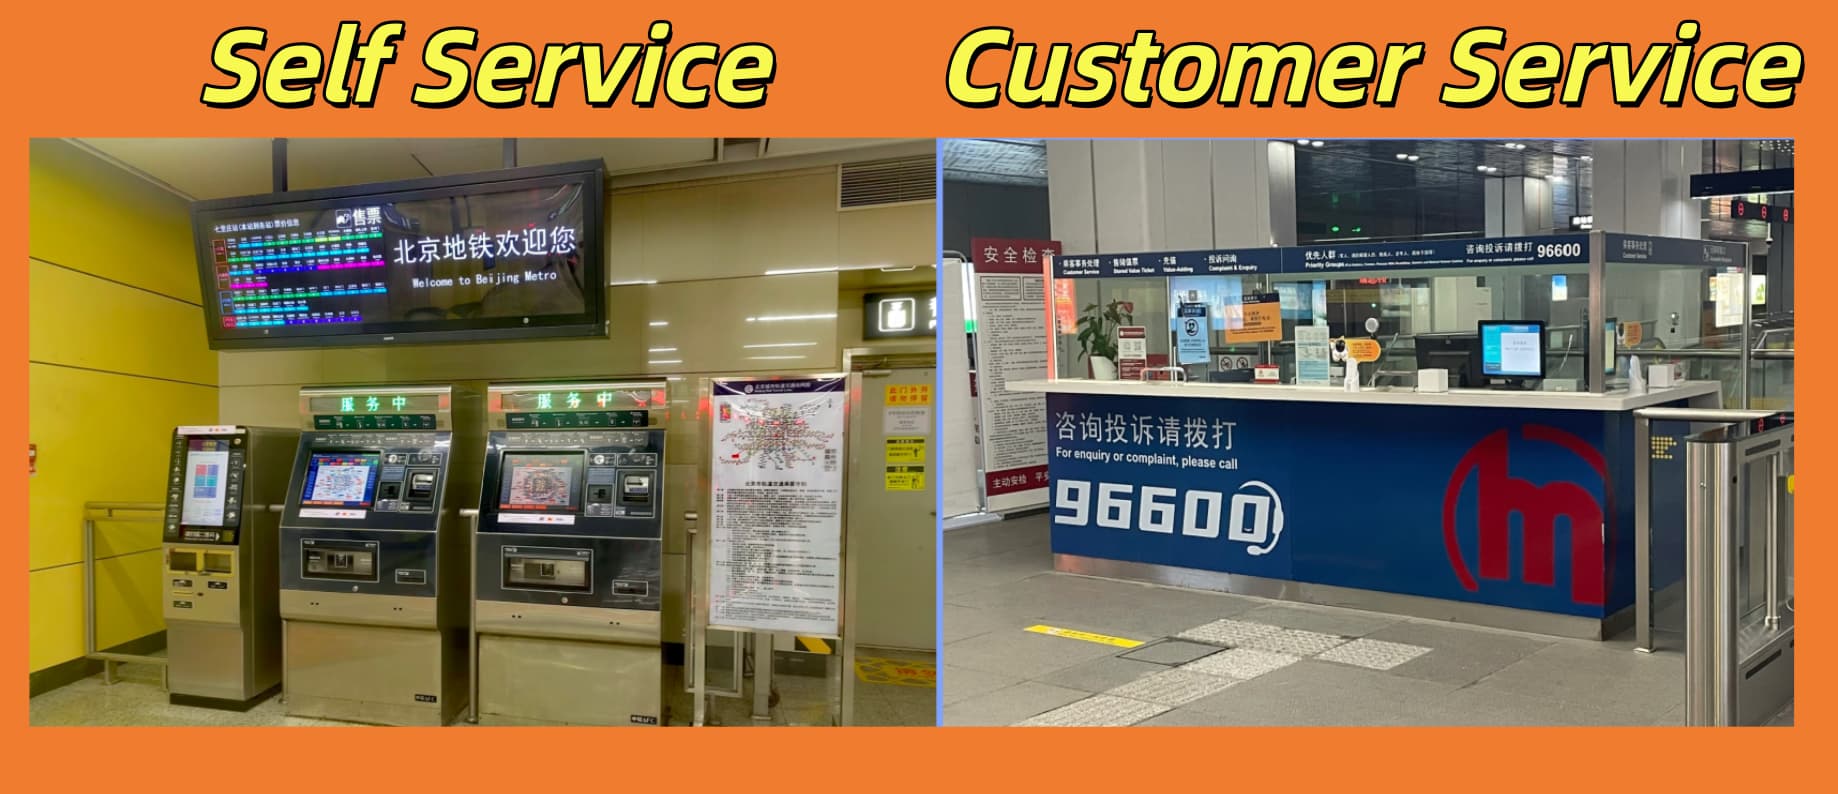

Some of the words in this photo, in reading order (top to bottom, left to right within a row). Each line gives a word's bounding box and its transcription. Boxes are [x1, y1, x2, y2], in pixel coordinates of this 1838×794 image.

[352, 206, 382, 226] 售票
[393, 226, 576, 264] 北京地铁欢迎您
[1466, 242, 1533, 254] 咨询投诉请拨打
[1537, 243, 1581, 258] 96600
[412, 277, 453, 289] Welcome
[459, 275, 471, 286] to
[476, 271, 519, 285] Beijing
[525, 270, 557, 281] Metro
[340, 396, 406, 412] 服务中
[537, 391, 613, 409] 服务中
[1055, 411, 1237, 451] 咨询投诉请拨打
[1056, 447, 1072, 458] For
[1074, 449, 1111, 463] enquiry
[1113, 453, 1124, 462] or
[1126, 452, 1179, 467] complaint,
[1181, 456, 1216, 469] please
[1218, 458, 1238, 470] call
[1055, 479, 1270, 544] 96600
